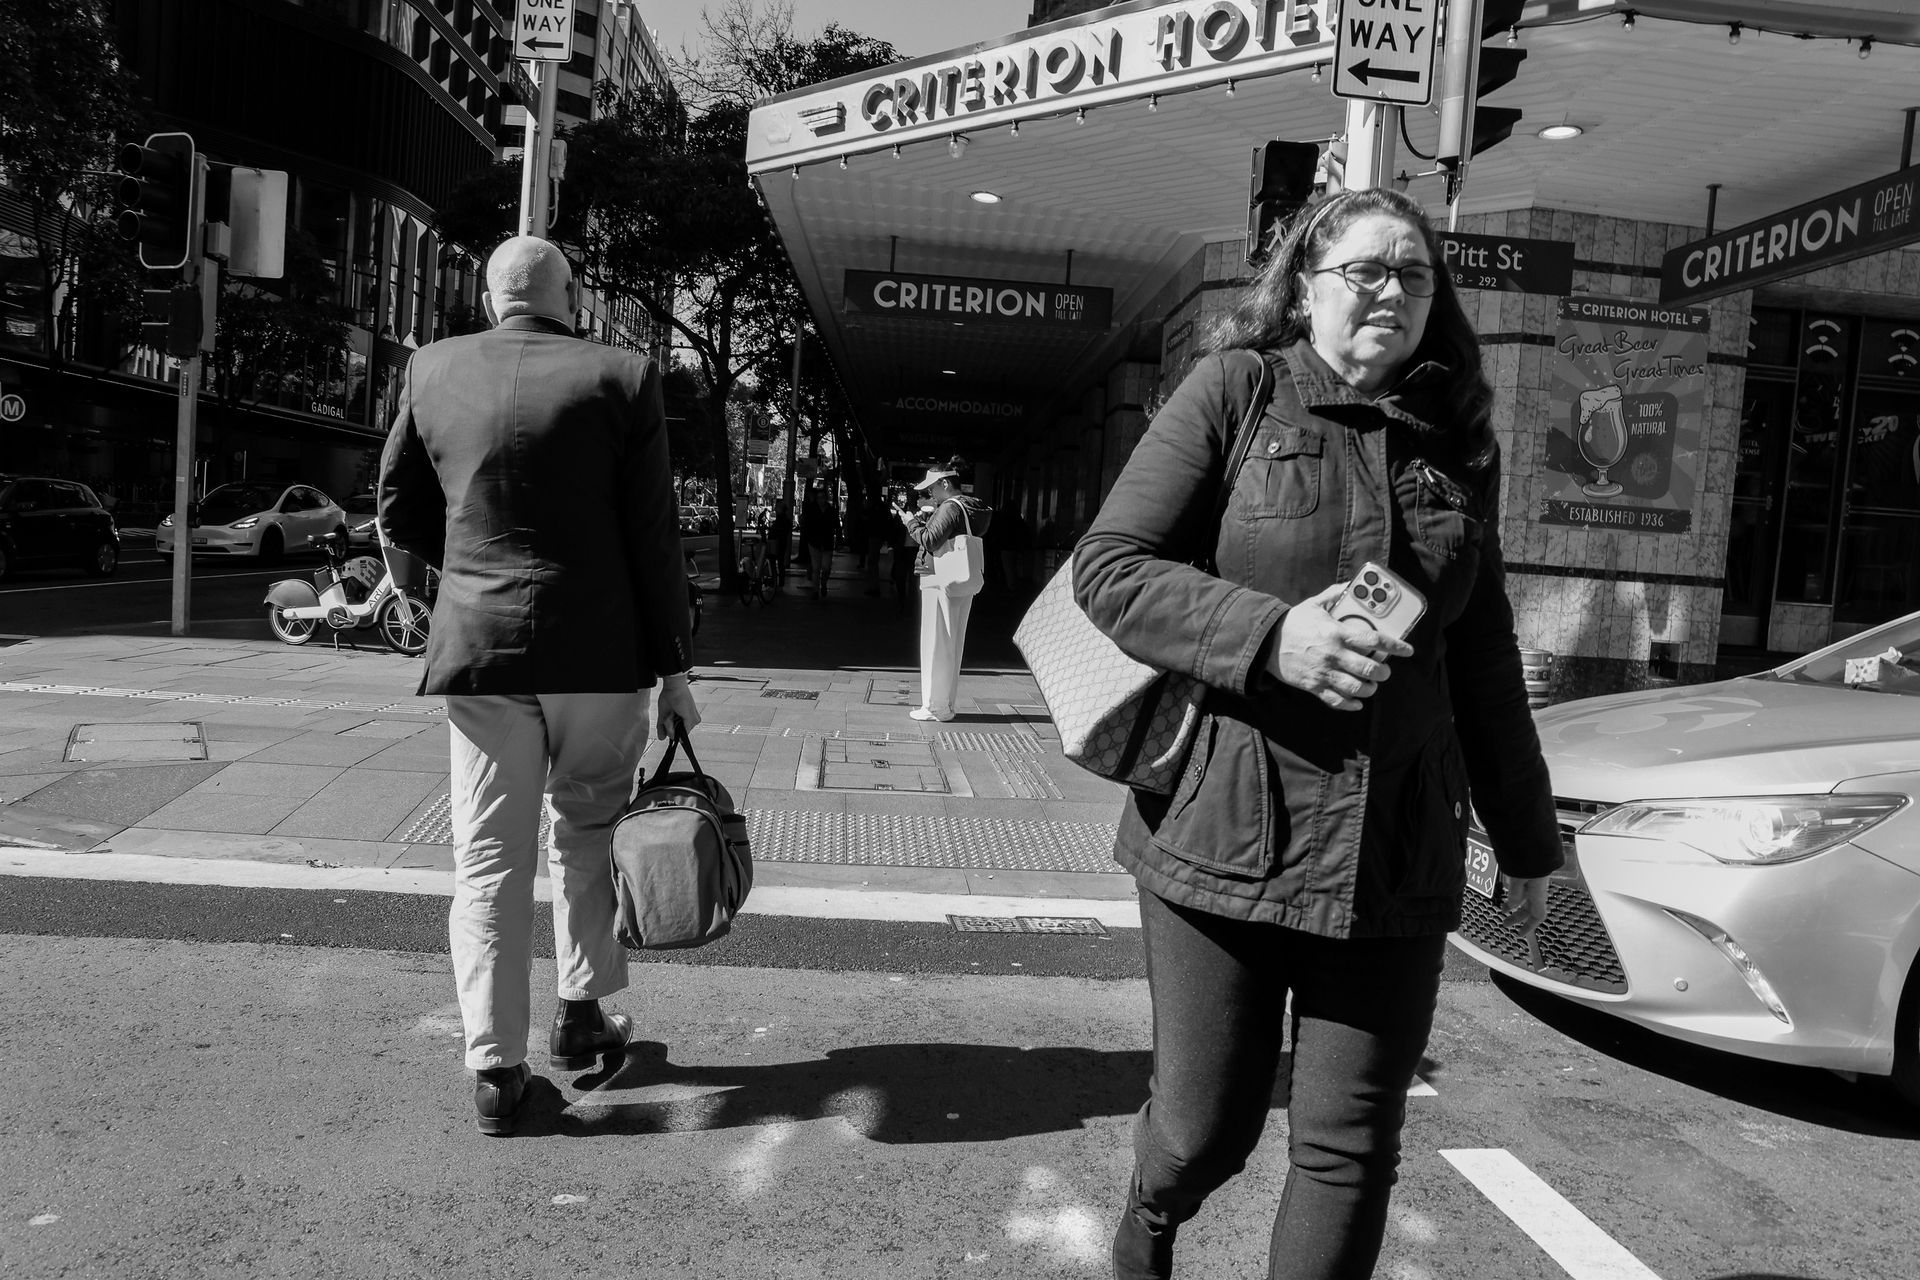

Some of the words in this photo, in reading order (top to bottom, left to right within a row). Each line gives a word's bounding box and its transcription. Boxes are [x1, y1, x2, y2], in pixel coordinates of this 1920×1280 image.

[523, 14, 567, 32] WAY
[1350, 18, 1426, 53] WAY
[861, 27, 1121, 130] CRITERION
[1873, 180, 1915, 216] OPEN
[1872, 216, 1888, 232] TILL
[1890, 208, 1911, 227] LATE
[1682, 198, 1862, 288] CRITERION
[1442, 239, 1489, 268] Pitt
[1496, 243, 1523, 271] St
[1478, 275, 1497, 287] 292
[873, 279, 1046, 318] CRITERION
[1055, 293, 1084, 311] OPEN
[1582, 303, 1647, 321] CRITERION
[1650, 310, 1689, 326] HOTEL
[1559, 334, 1611, 361] Great
[1613, 329, 1659, 355] Beer
[1613, 358, 1663, 387] Great
[1662, 355, 1705, 377] Times
[4, 400, 20, 416] M
[311, 401, 345, 419] GADIGAL
[895, 396, 1024, 417] ACCOMMODATION
[1638, 403, 1664, 417] 100%
[1631, 420, 1667, 436] NATURAL
[1569, 506, 1636, 525] ESTABLISHED
[1640, 512, 1664, 527] 1936
[1465, 845, 1489, 873] 129
[1467, 870, 1484, 886] TAXI
